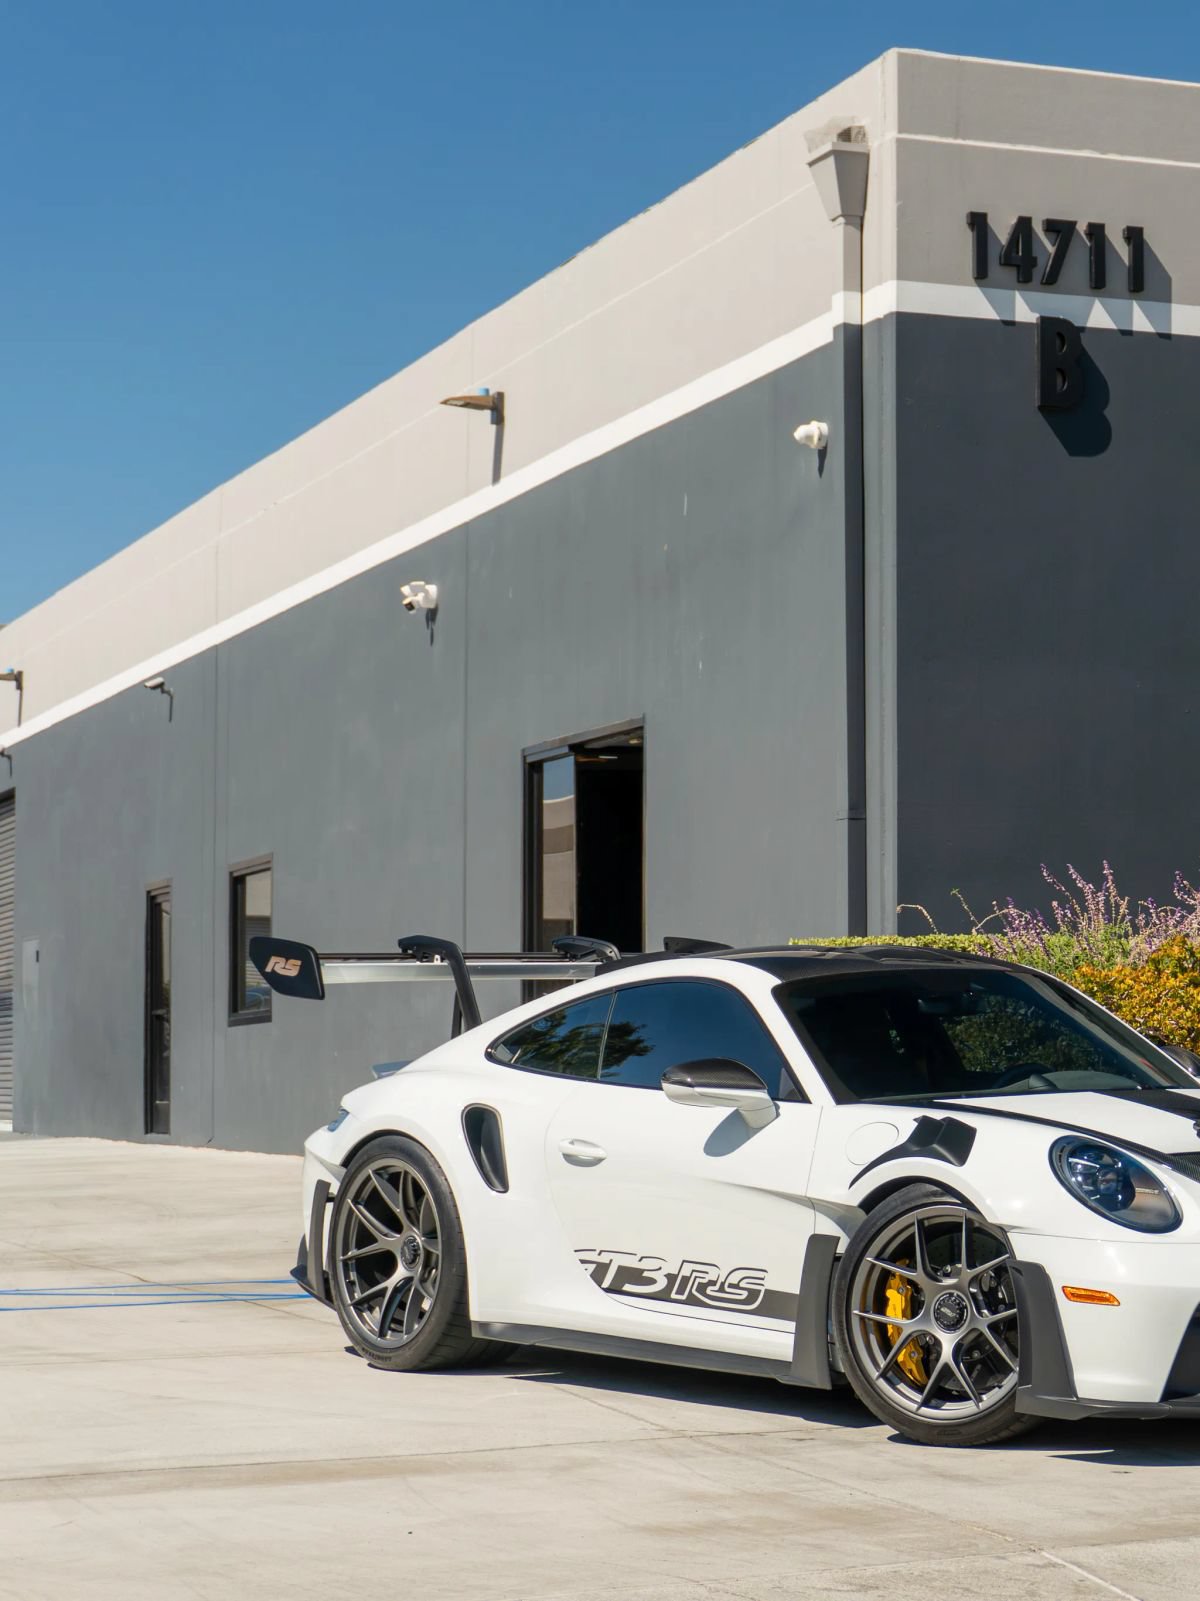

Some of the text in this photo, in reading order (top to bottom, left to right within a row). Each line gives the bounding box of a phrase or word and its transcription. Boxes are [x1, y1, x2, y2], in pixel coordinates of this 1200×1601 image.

[966, 211, 1146, 293] 14711
[1036, 315, 1086, 410] B
[265, 955, 302, 977] RS
